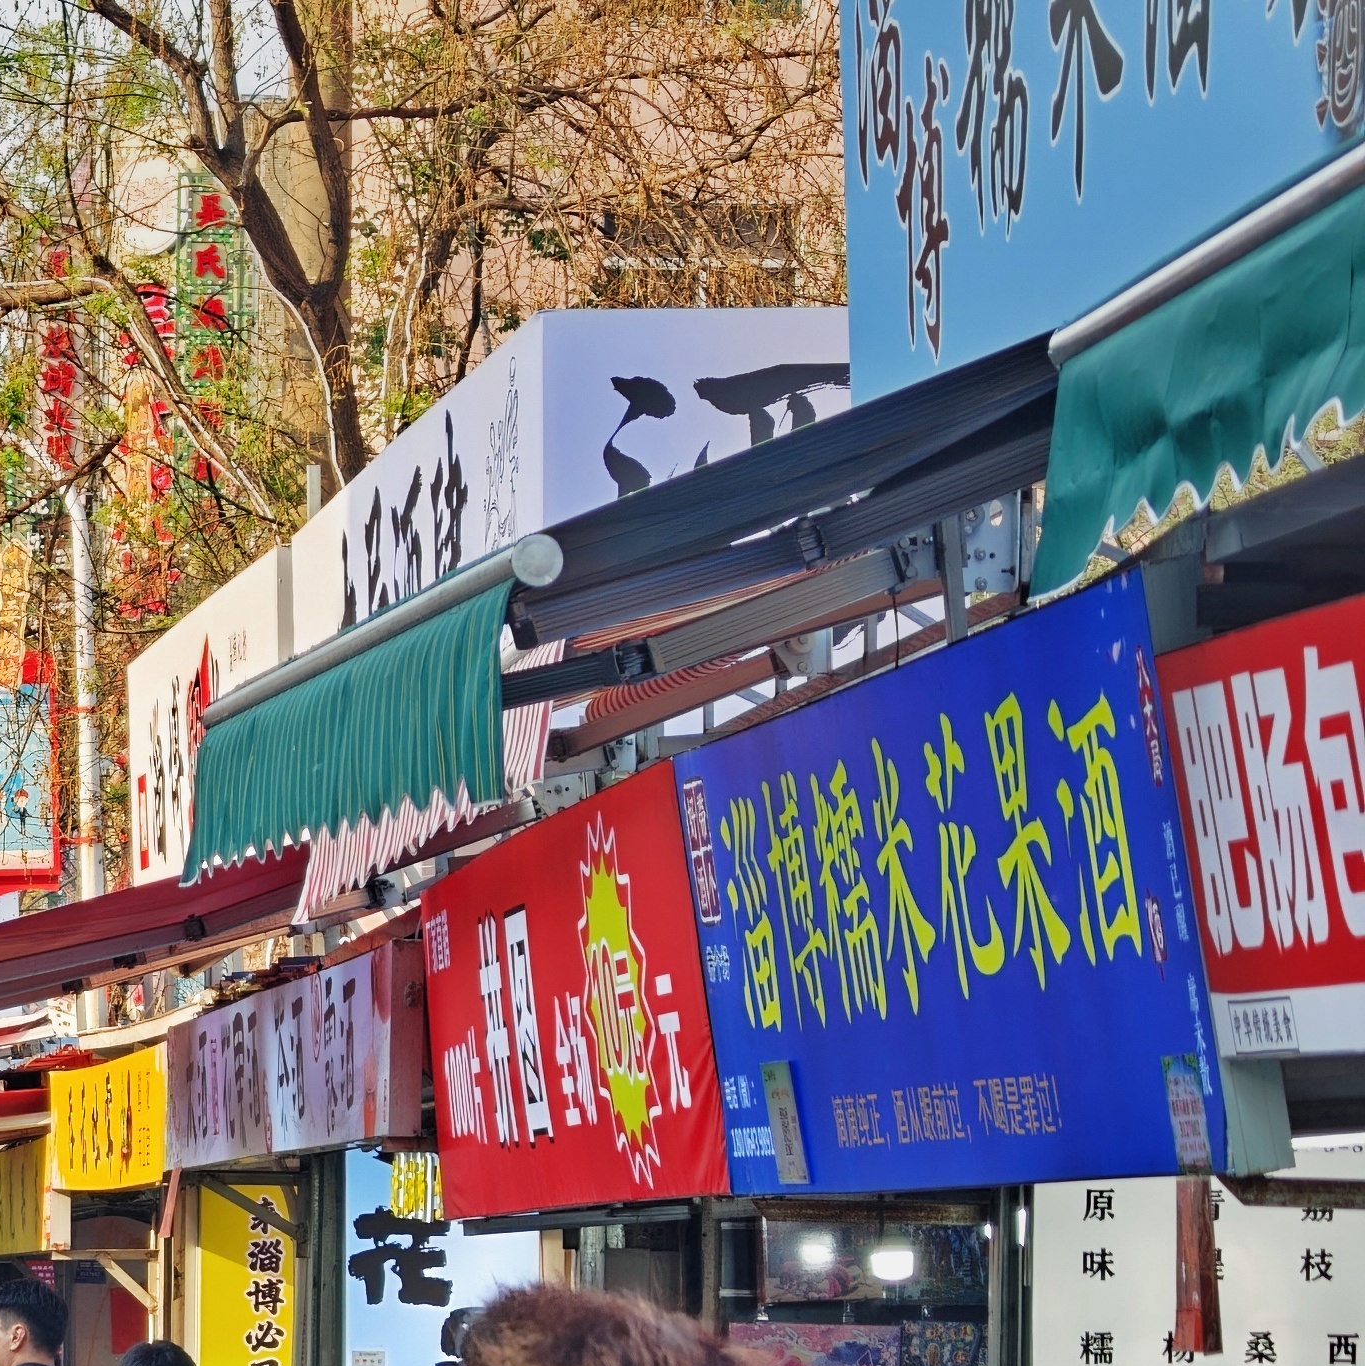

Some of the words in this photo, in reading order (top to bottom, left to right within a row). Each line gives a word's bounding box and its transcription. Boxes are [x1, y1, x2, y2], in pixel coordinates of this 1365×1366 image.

[720, 692, 1147, 1035] 淄博糯米花果酒
[1171, 645, 1365, 958] 肥肠包
[476, 903, 555, 1151] 拼图
[554, 991, 598, 1127] 全场
[1232, 1006, 1295, 1044] 中华传统美食
[1081, 1187, 1116, 1282] 原味
